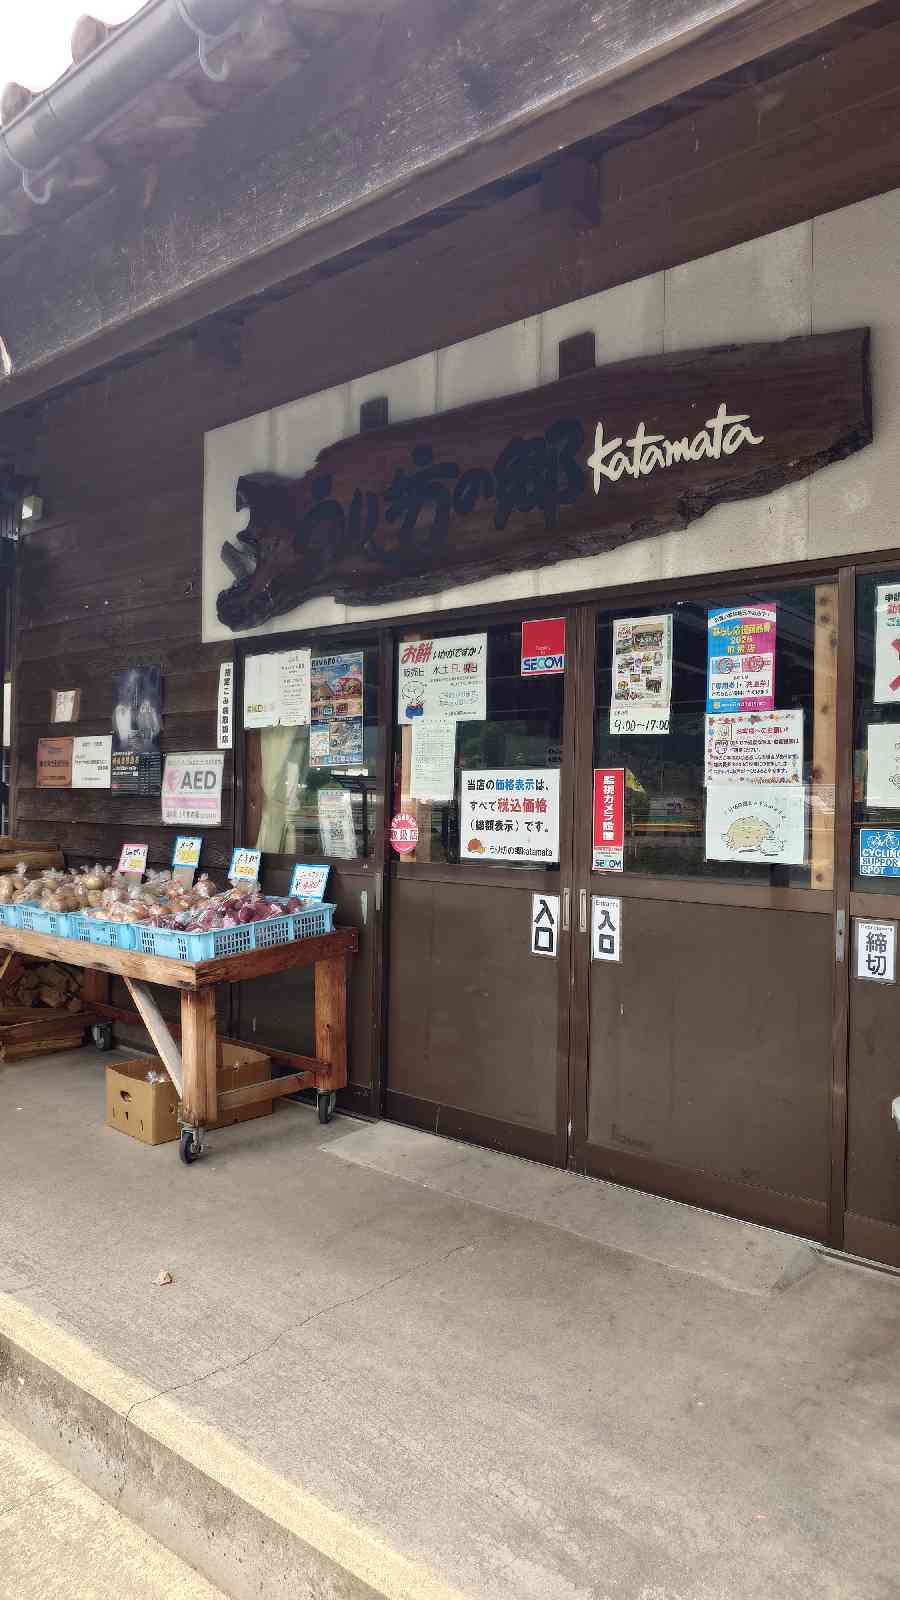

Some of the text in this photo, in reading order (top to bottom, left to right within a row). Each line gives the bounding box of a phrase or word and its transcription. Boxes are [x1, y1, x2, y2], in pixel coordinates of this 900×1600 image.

[298, 418, 586, 555] うり坊の郷
[523, 655, 563, 671] SECOM
[180, 770, 217, 790] AED
[467, 778, 549, 791] 当店の価格表示は、
[470, 797, 548, 813] すべて税込価格
[602, 775, 615, 841] 監視カメラ設置
[862, 857, 900, 867] SUPPOR
[862, 865, 884, 875] SPOT
[534, 899, 555, 952] 入口
[597, 909, 616, 954] 入口
[865, 931, 888, 976] 締切
